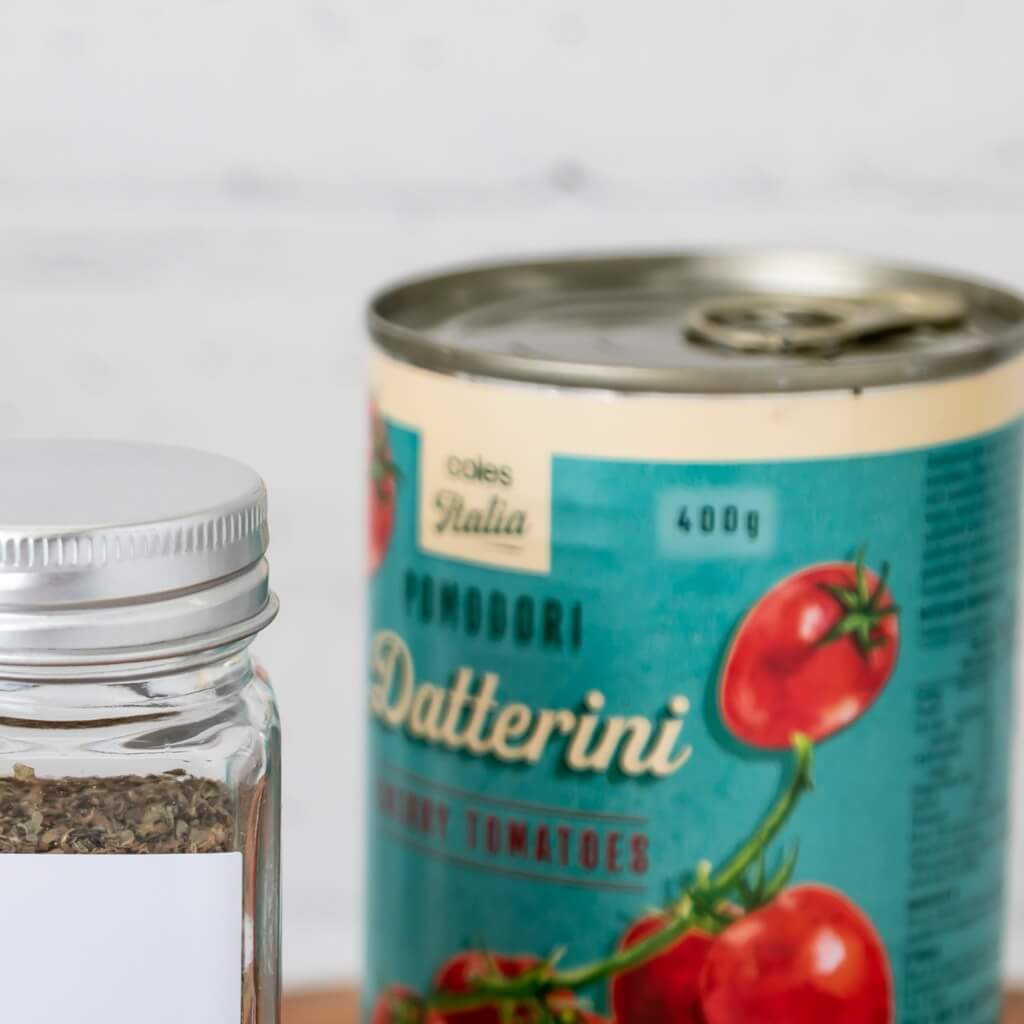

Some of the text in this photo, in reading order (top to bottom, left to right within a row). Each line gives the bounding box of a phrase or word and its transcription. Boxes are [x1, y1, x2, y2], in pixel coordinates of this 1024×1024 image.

[446, 454, 513, 487] coles
[434, 489, 530, 537] Italia
[676, 504, 759, 540] 400g
[403, 568, 583, 651] POMODORI
[370, 629, 693, 778] Datterini
[465, 808, 650, 876] TOMATOES
